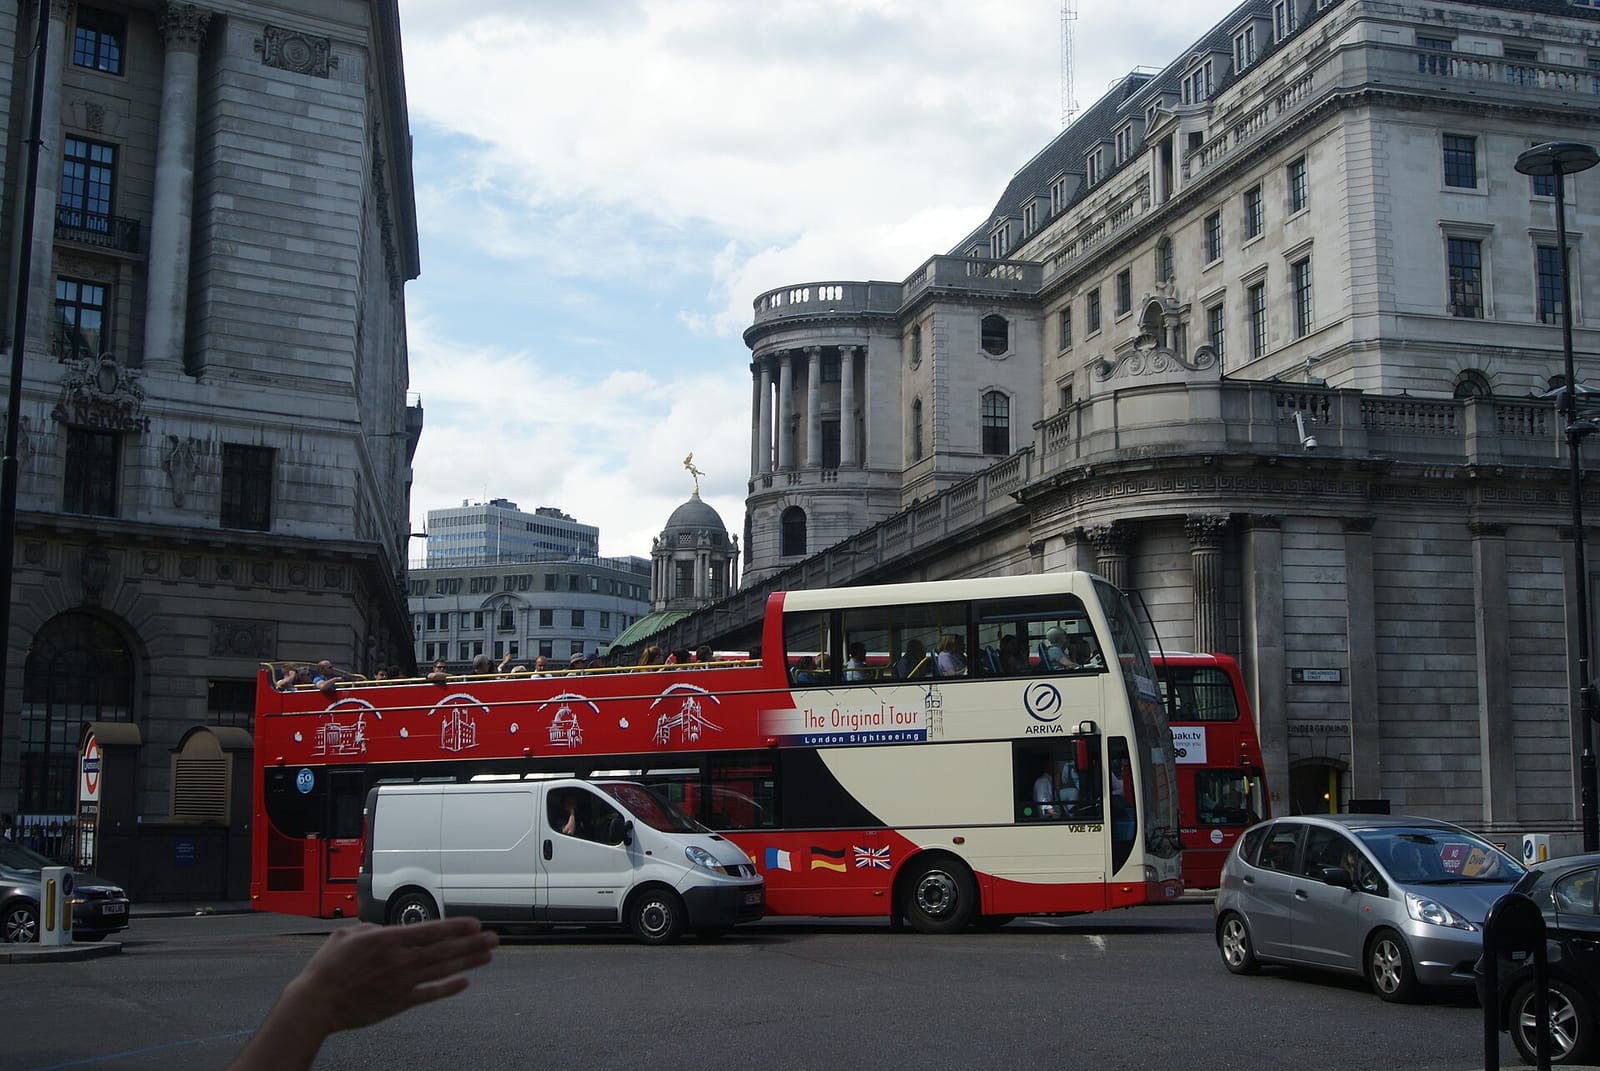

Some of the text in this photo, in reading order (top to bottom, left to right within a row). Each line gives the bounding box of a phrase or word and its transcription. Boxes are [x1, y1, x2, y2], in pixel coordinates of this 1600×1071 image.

[75, 407, 151, 432] NatWest
[804, 705, 918, 732] The Original Tour
[1025, 724, 1064, 735] ARRIVA
[804, 732, 919, 744] London Sightseeing
[298, 773, 312, 785] 60
[1068, 824, 1086, 833] VXE
